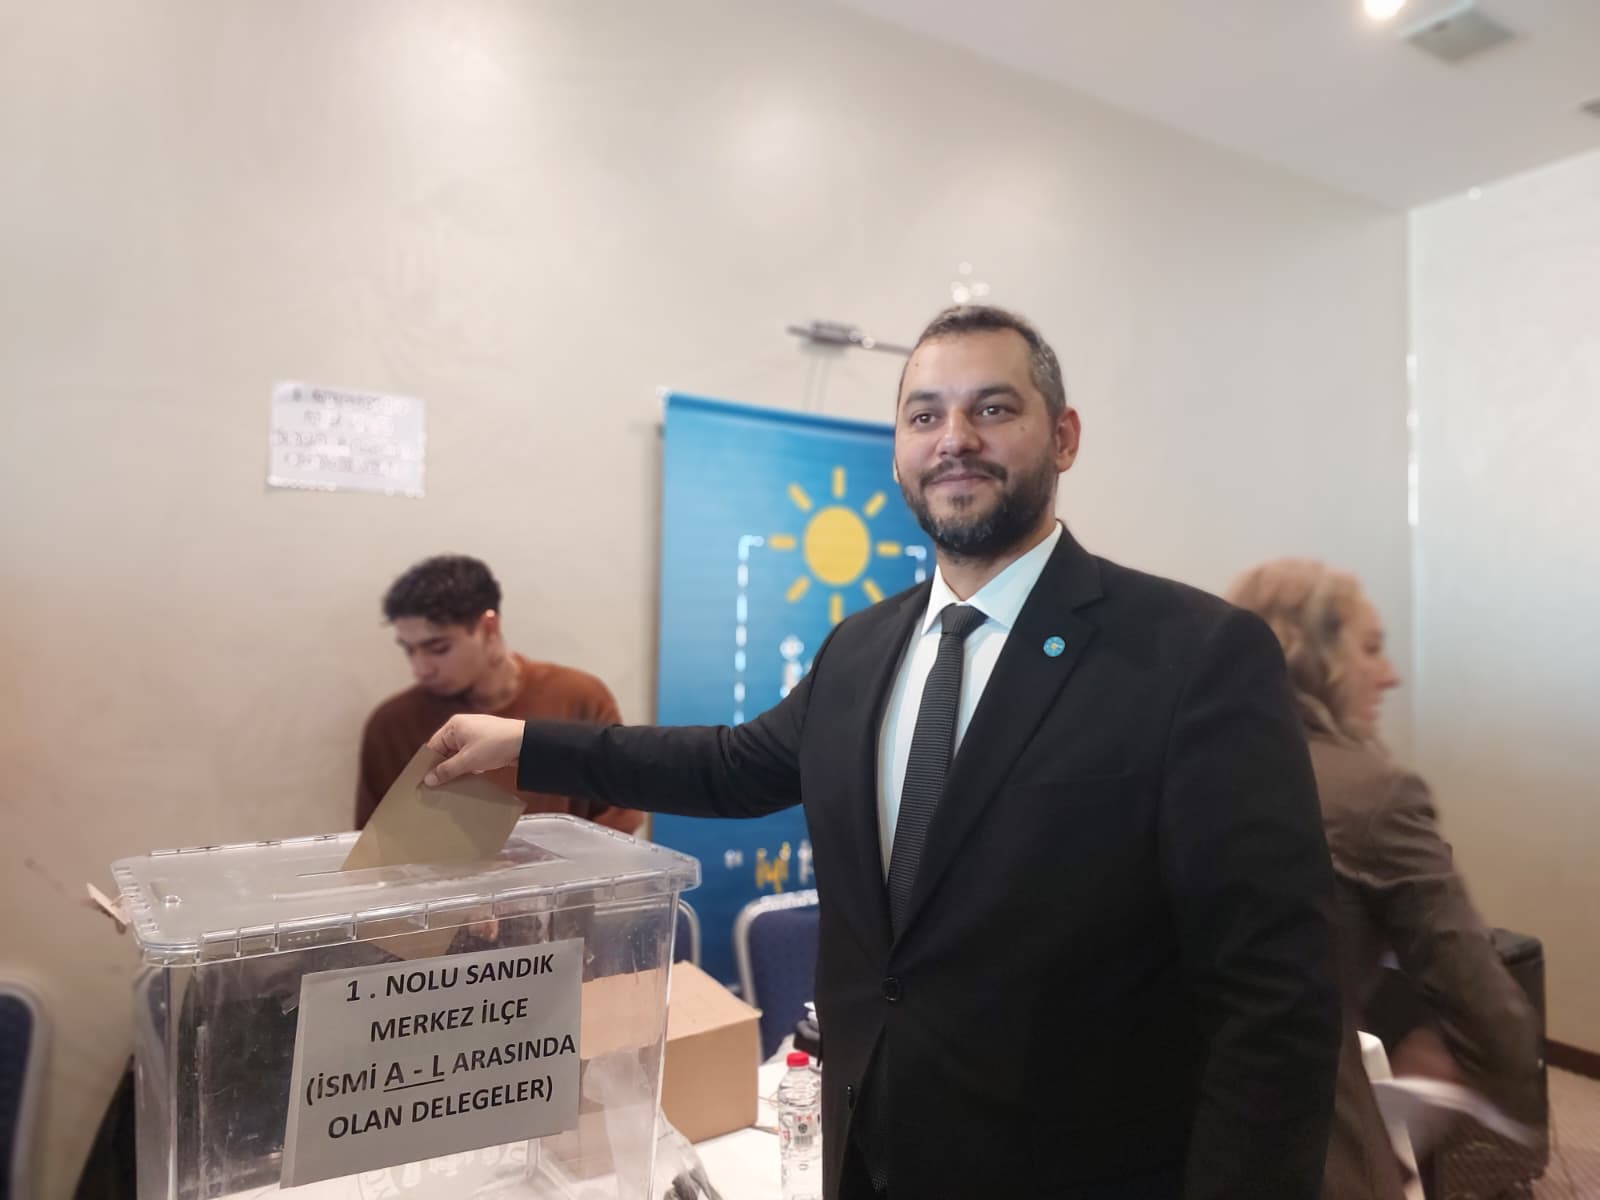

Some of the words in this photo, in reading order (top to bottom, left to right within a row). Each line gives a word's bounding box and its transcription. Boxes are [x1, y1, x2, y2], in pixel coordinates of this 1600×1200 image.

[385, 967, 459, 997] NOLU
[465, 953, 555, 985] SANDIK
[370, 1005, 475, 1043] MERKEZ
[481, 997, 529, 1026] İLÇE
[305, 1062, 377, 1107] (İSMİ
[451, 1034, 576, 1074] ARASINDA
[328, 1104, 403, 1139] OLAN
[411, 1074, 553, 1123] DELEGELER)
